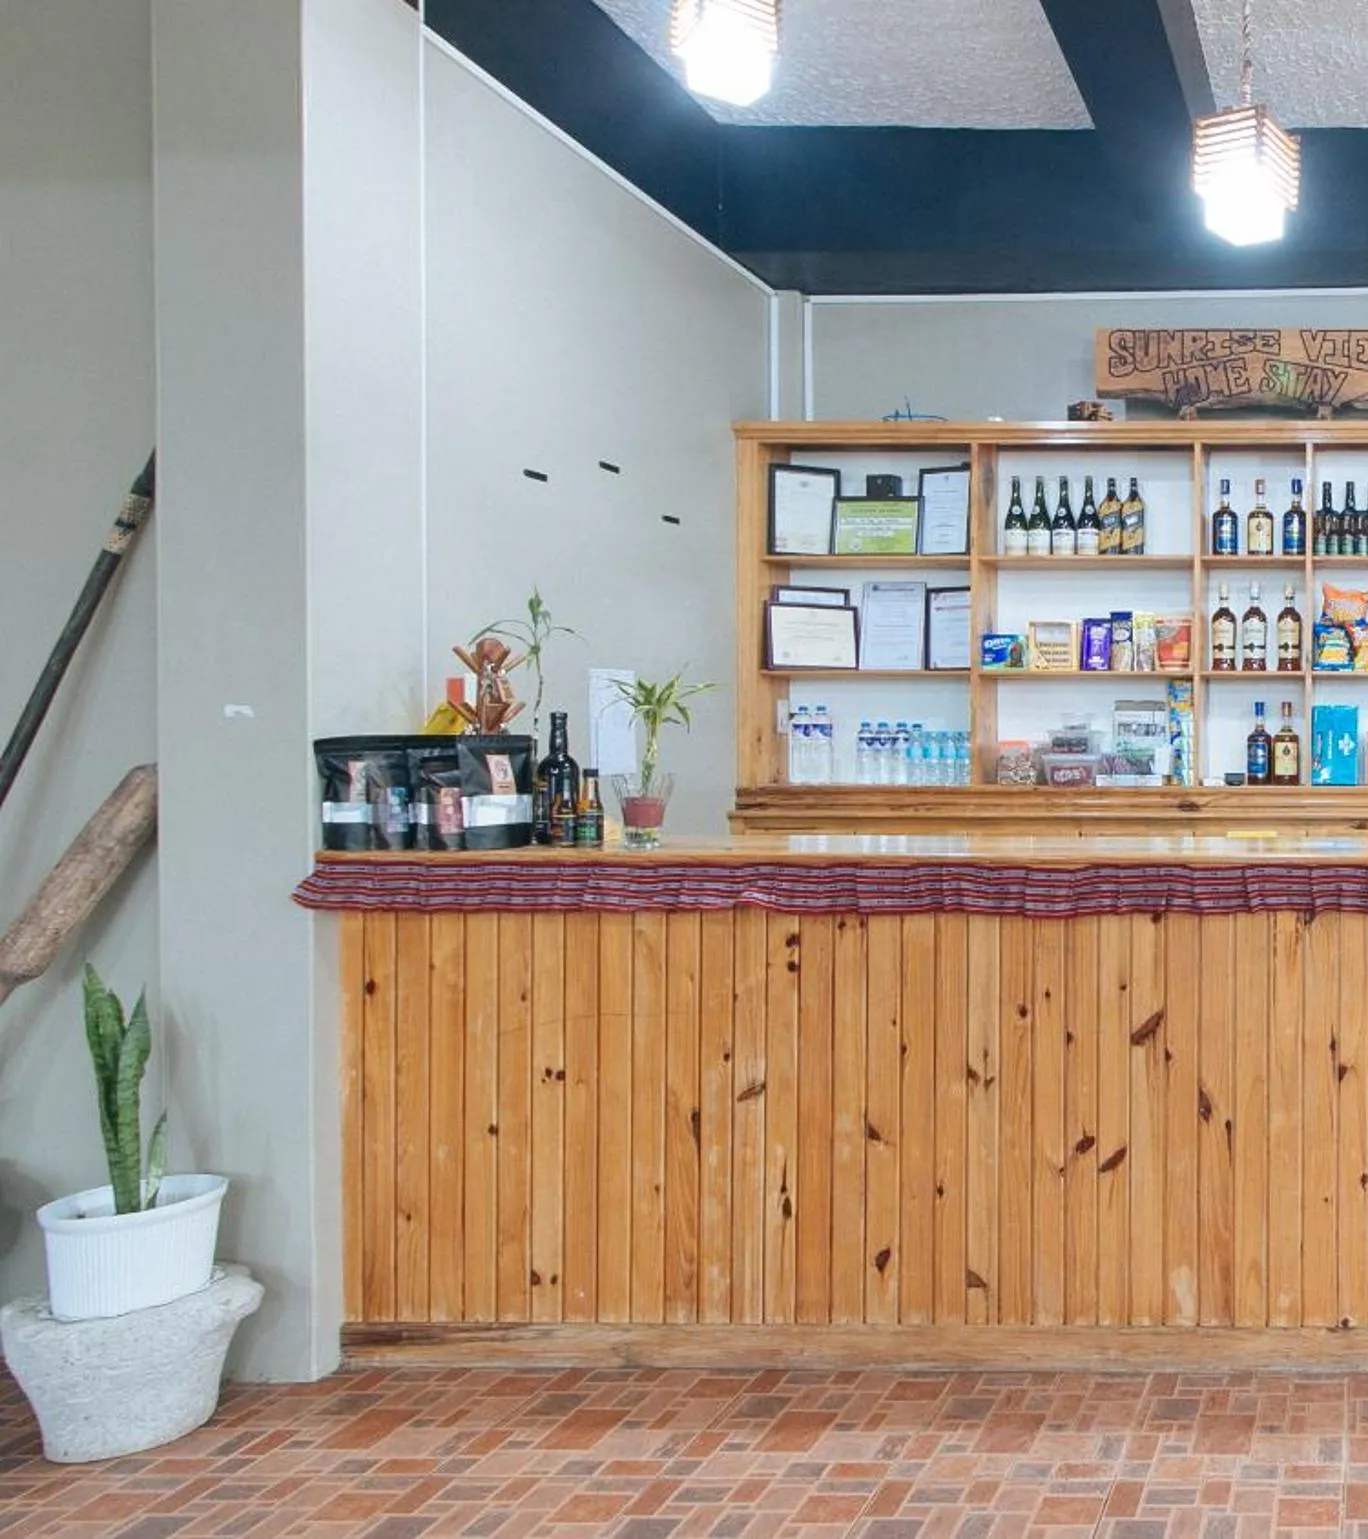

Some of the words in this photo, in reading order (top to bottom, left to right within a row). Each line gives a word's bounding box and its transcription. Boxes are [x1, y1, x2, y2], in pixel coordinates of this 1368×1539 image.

[1108, 329, 1281, 377] SUNRISE
[1162, 357, 1251, 403] HOME
[1259, 359, 1348, 401] STAY
